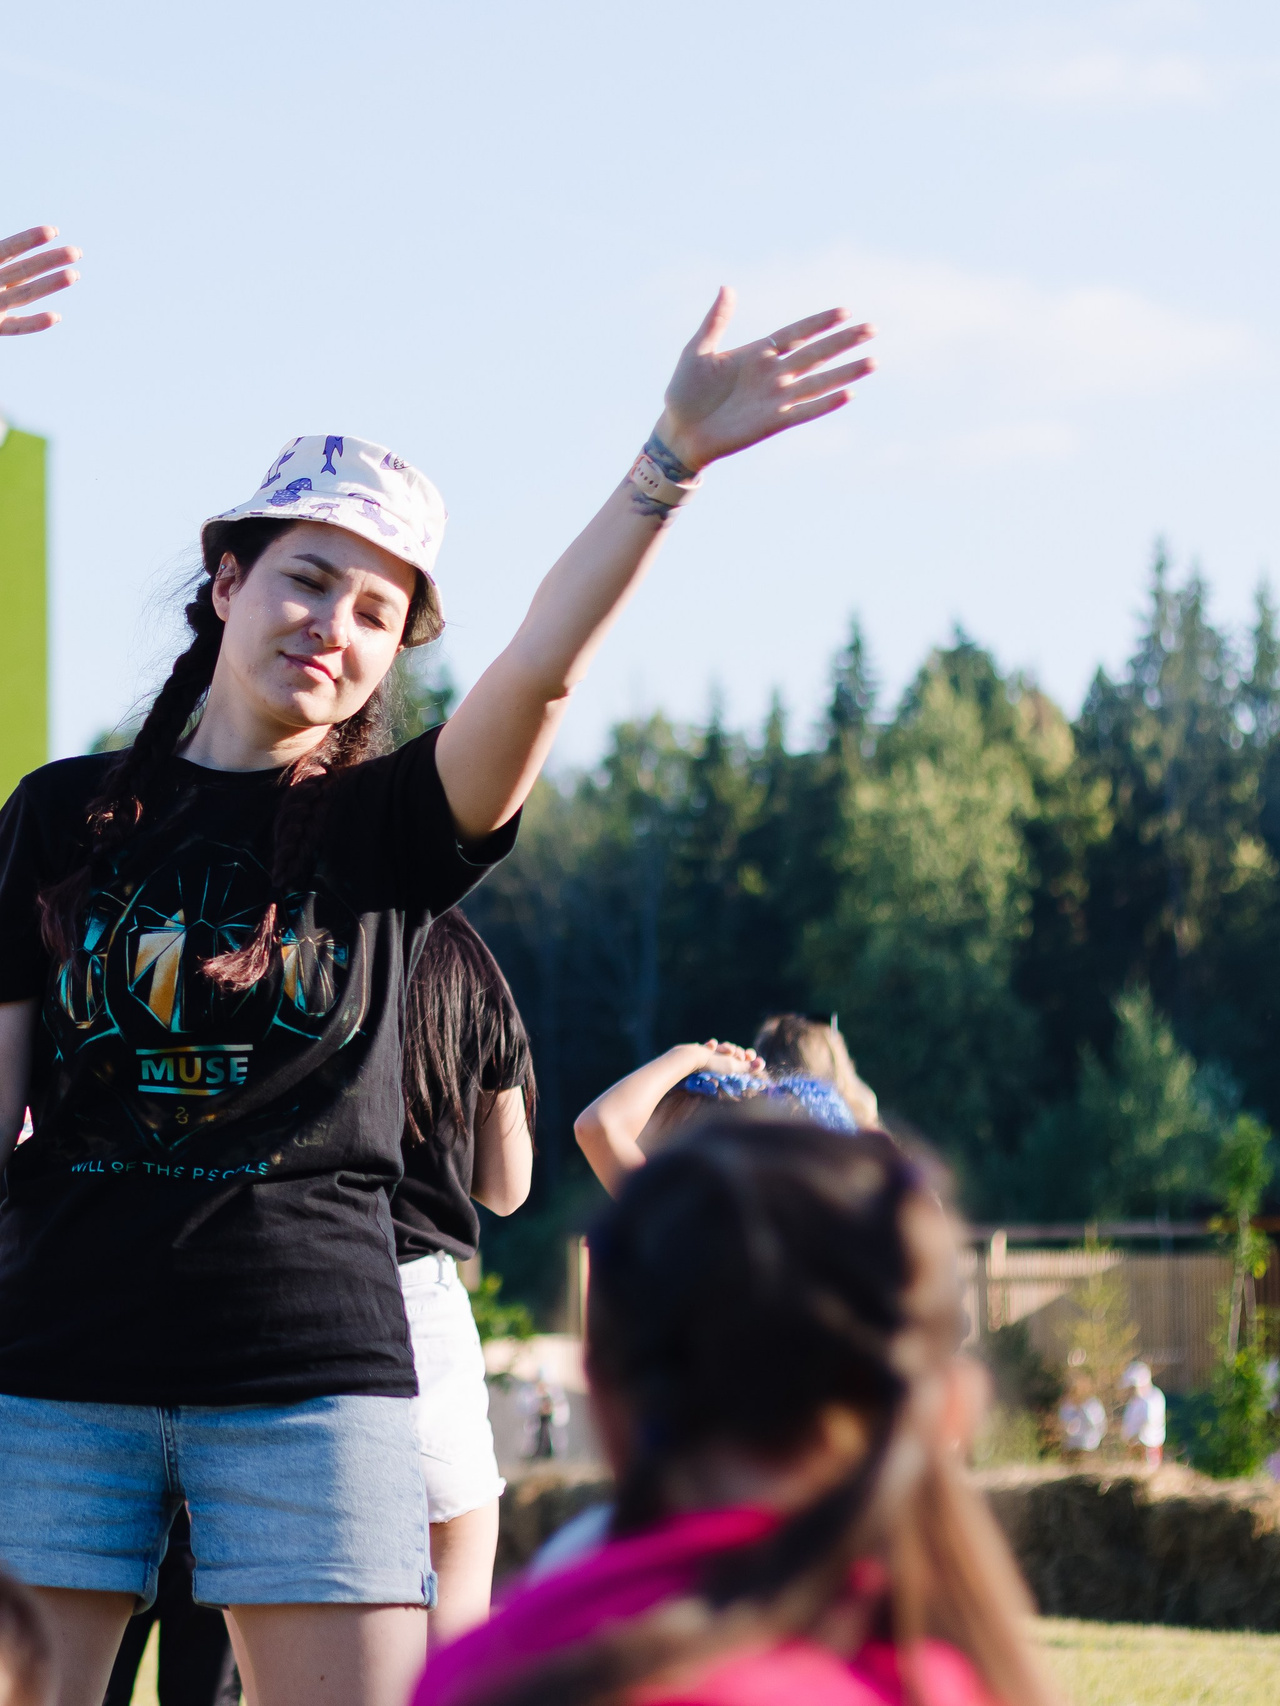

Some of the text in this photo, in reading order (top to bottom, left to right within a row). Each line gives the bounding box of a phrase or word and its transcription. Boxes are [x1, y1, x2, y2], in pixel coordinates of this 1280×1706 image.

[140, 1056, 249, 1085] MUSE
[71, 1160, 105, 1173] WILL
[111, 1161, 137, 1174] OF
[142, 1161, 185, 1178] THE
